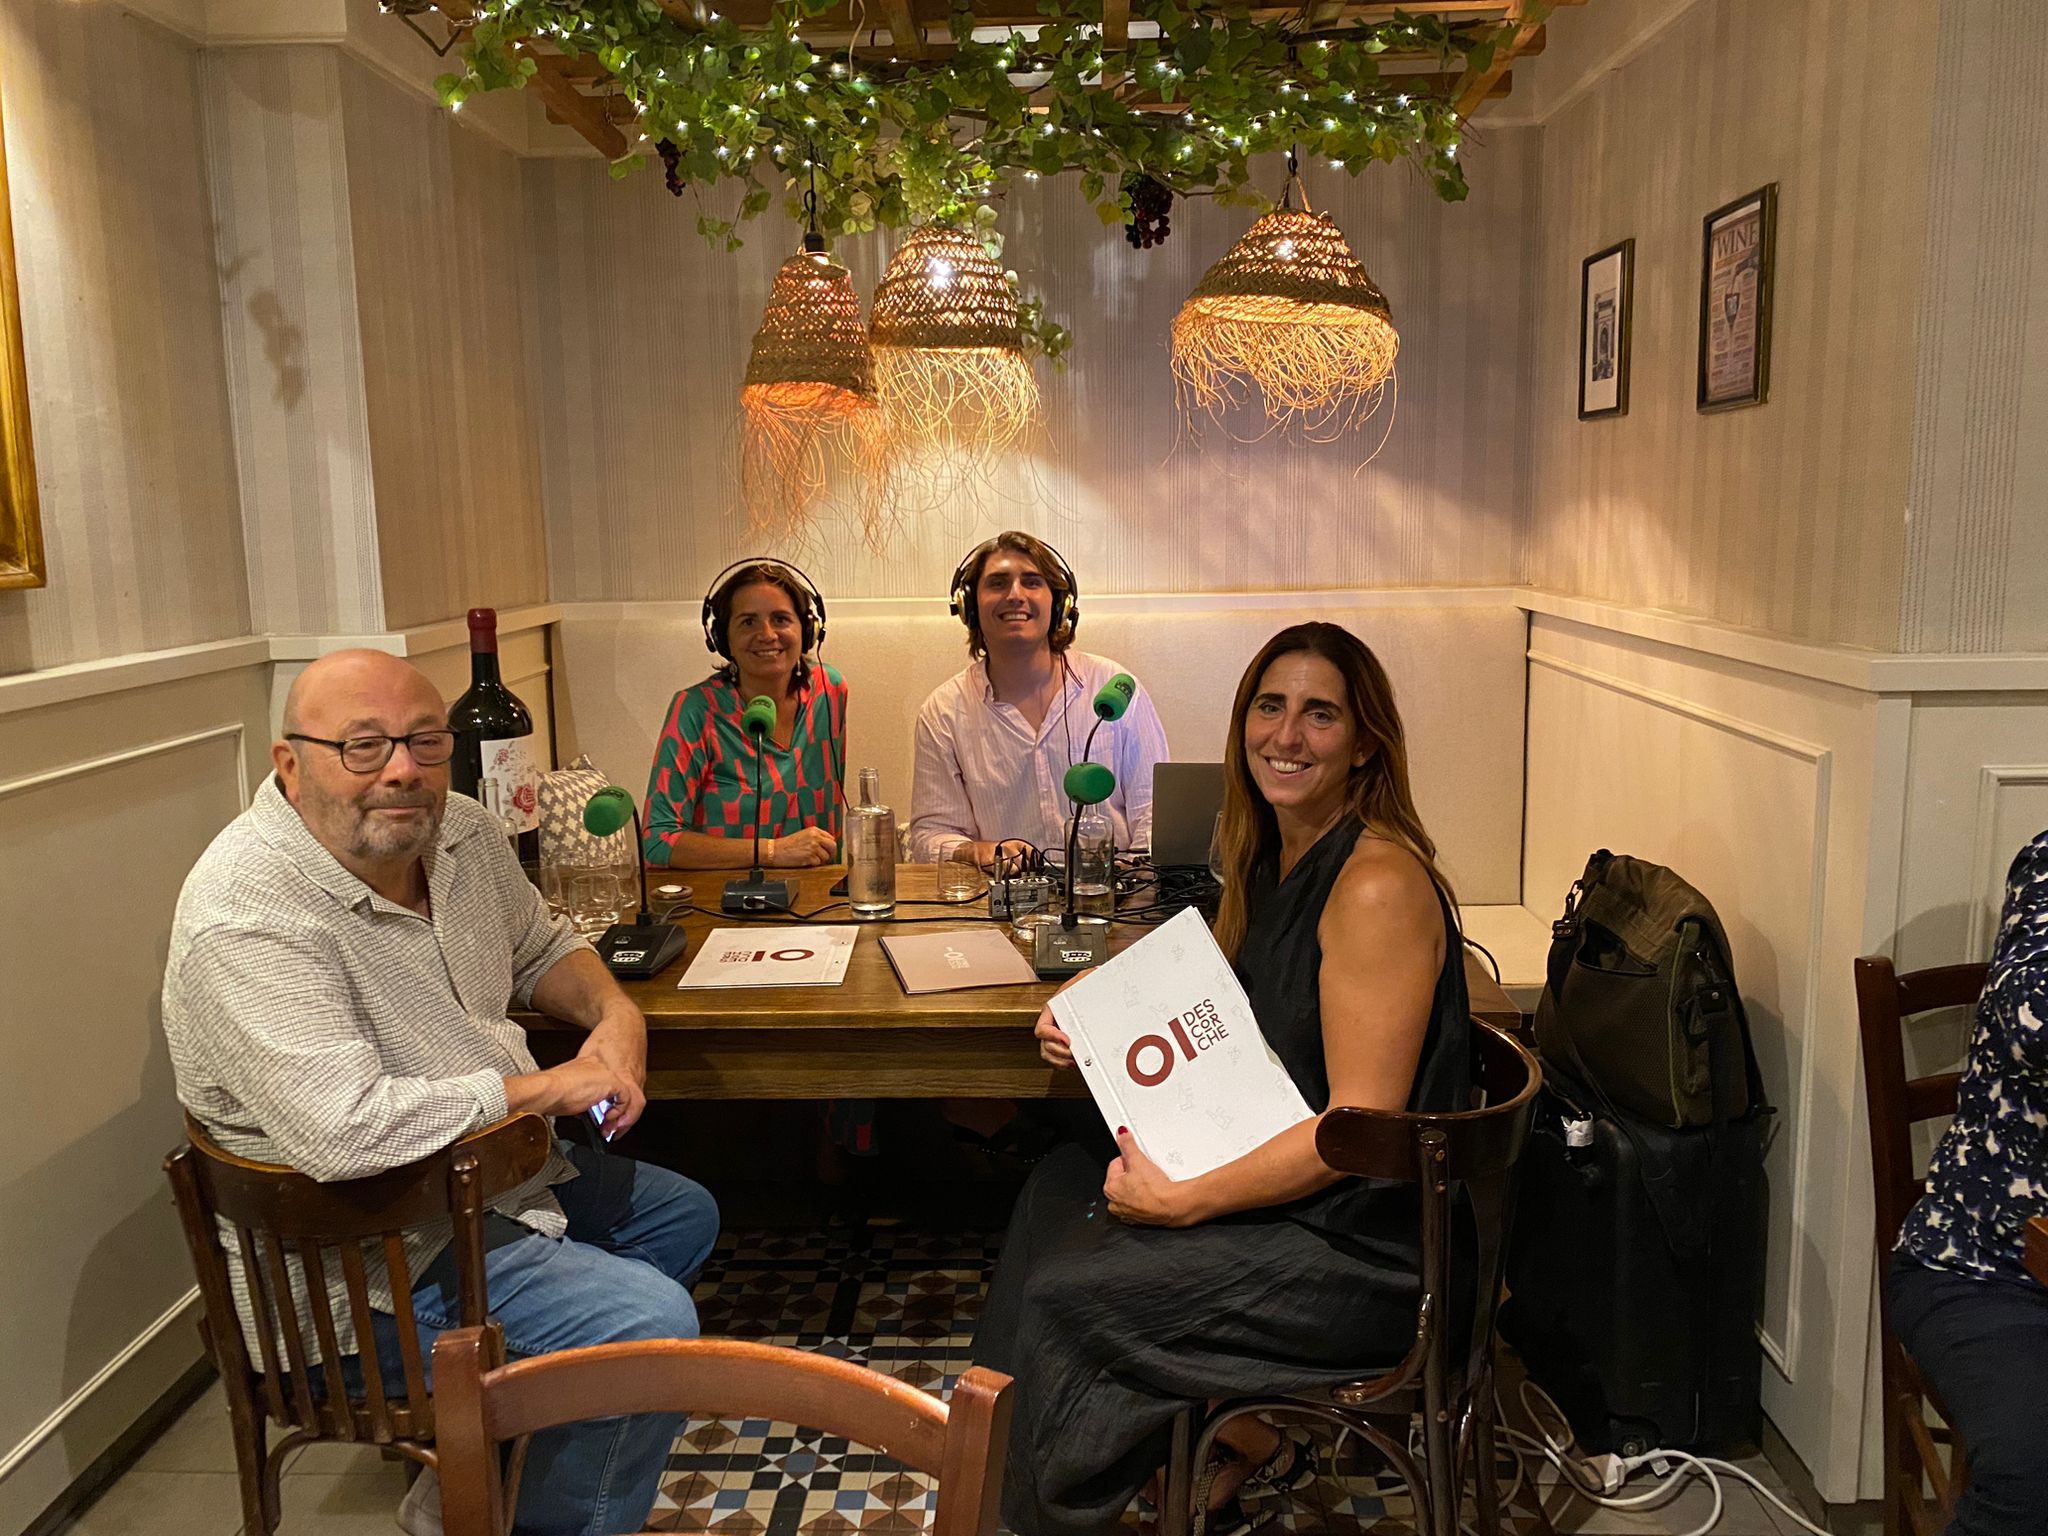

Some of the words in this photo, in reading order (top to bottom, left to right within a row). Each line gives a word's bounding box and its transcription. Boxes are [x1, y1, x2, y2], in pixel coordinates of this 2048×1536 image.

[1716, 220, 1758, 259] WINE
[1182, 998, 1215, 1027] DES
[1197, 1024, 1230, 1051] CHE
